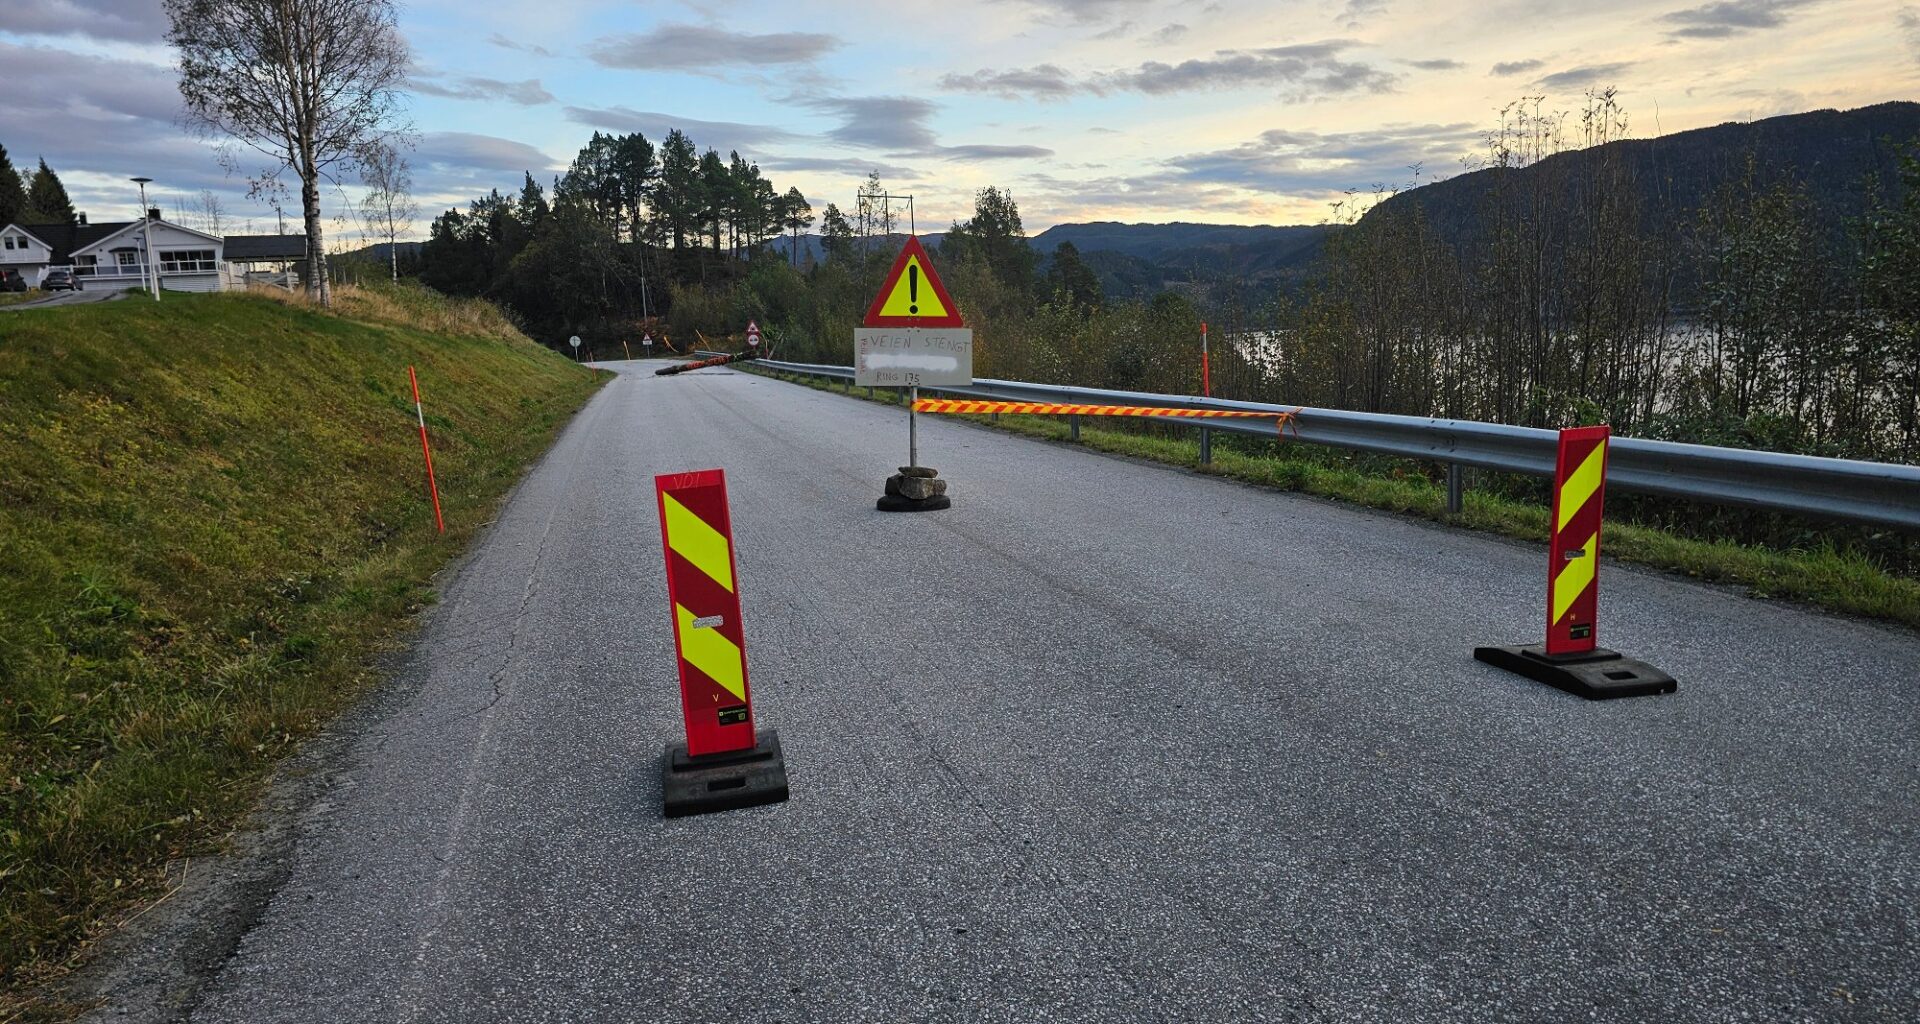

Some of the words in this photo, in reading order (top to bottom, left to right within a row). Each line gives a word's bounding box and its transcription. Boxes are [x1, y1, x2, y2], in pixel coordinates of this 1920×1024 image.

[870, 335, 911, 348] VEIEN
[924, 336, 970, 352] STENGT
[876, 372, 898, 382] RING
[904, 372, 920, 382] 175
[712, 693, 719, 702] V
